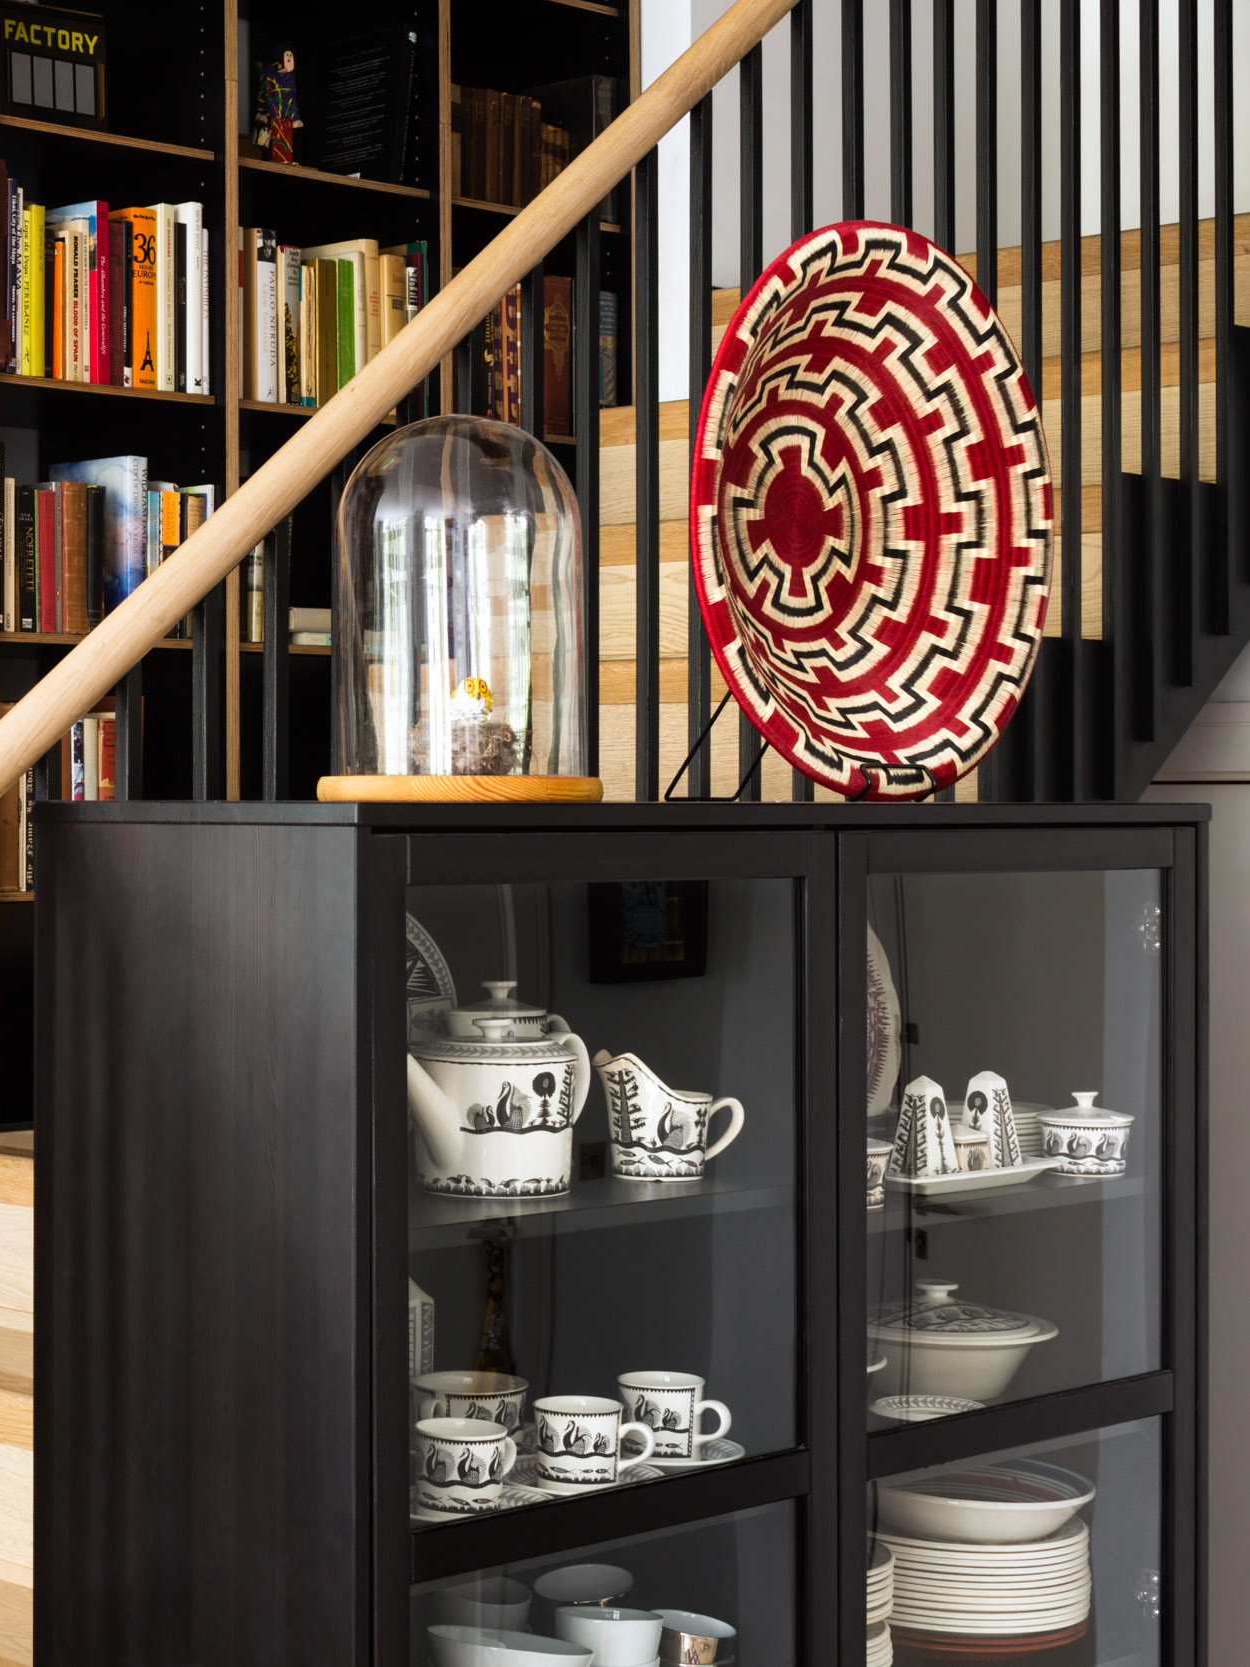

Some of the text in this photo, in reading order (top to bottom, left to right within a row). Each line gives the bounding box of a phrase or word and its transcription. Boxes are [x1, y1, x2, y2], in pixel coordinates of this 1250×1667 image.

[4, 18, 99, 55] FACTORY
[133, 233, 157, 266] 36
[131, 270, 158, 280] EUROPE
[74, 328, 78, 339] OF
[25, 527, 34, 592] NOFRETETE
